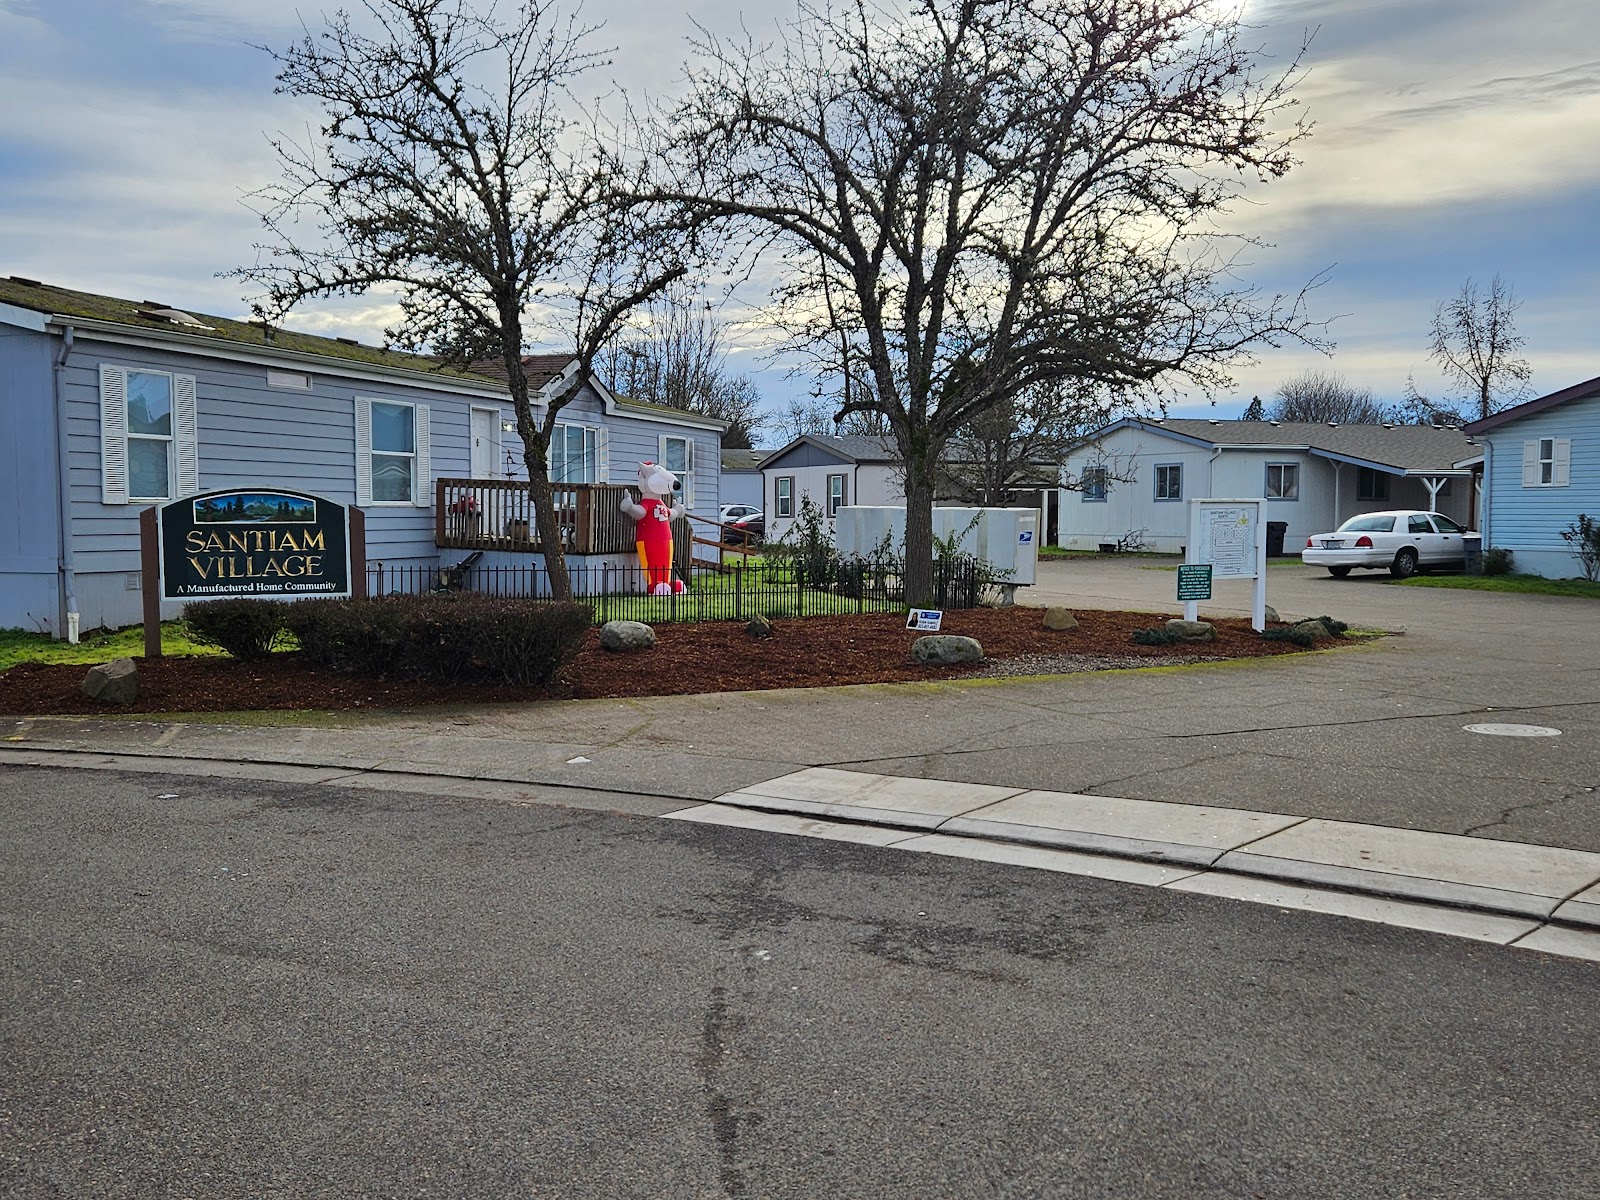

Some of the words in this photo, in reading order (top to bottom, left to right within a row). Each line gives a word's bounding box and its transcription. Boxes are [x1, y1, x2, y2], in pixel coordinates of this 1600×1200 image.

[185, 529, 326, 553] SANTIAM
[186, 555, 324, 579] VILLAGE
[177, 584, 184, 593] A
[187, 583, 254, 593] Manufactured
[256, 582, 283, 591] Home
[285, 581, 337, 591] Community
